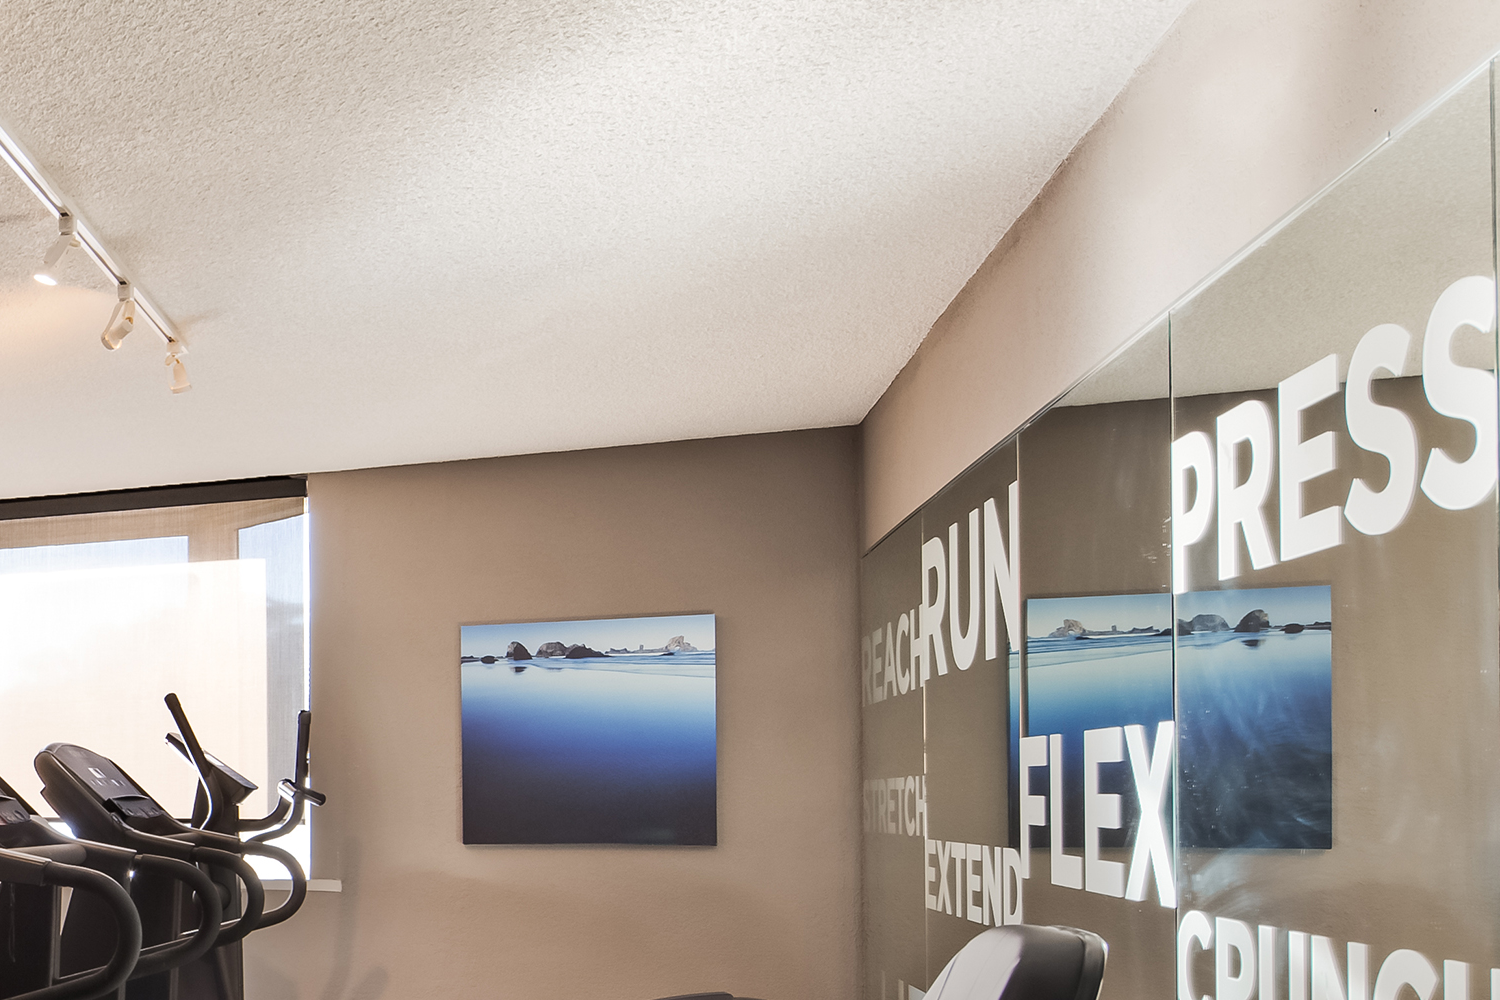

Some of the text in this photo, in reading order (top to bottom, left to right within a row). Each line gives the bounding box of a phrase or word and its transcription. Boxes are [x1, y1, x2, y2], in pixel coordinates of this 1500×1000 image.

[1171, 275, 1498, 594] PRESS
[922, 480, 1020, 682] RUN
[862, 602, 925, 707] REACH
[863, 774, 927, 836] STRETCH
[1020, 721, 1177, 909] FLEX
[926, 839, 1024, 927] EXTEND
